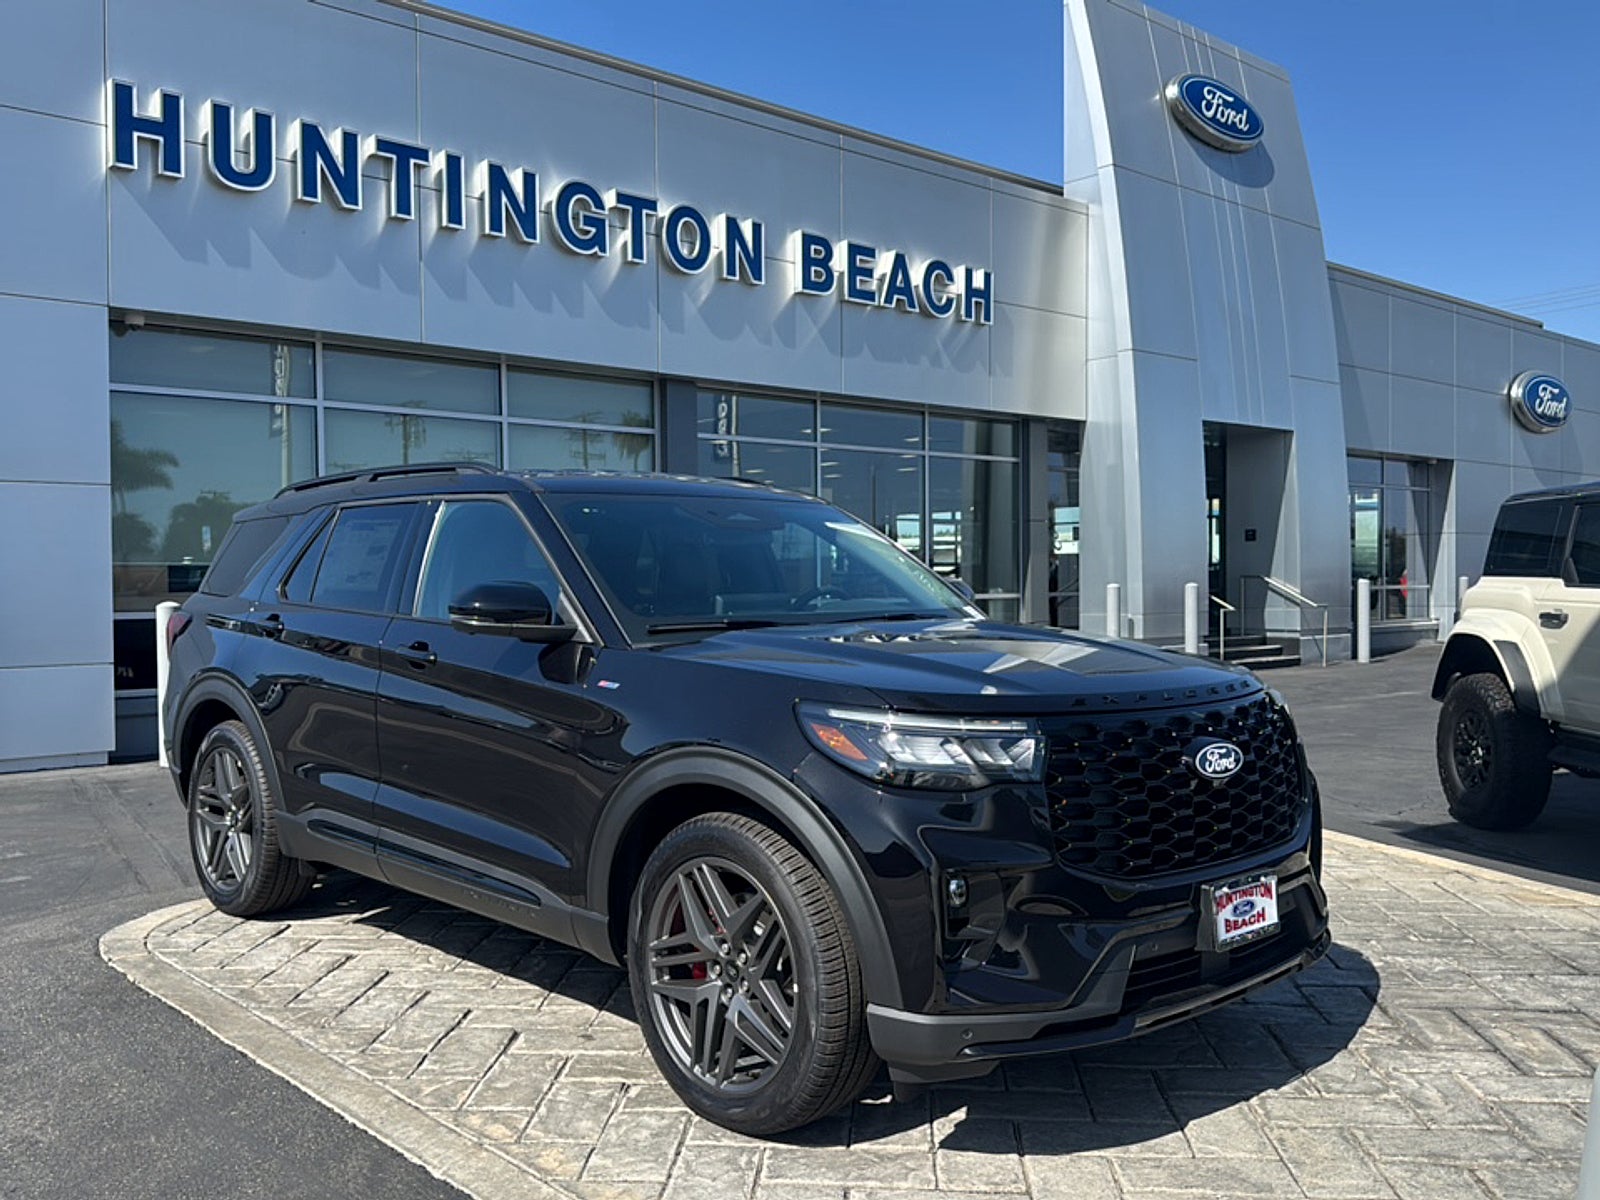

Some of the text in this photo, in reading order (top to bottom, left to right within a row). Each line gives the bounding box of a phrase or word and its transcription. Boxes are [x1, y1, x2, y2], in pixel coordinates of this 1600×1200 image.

[1201, 86, 1249, 131] Ford
[108, 78, 994, 325] HUNTINGTON BEACH
[1534, 383, 1567, 418] Ford
[1205, 748, 1236, 773] Ford
[1224, 907, 1266, 934] BEACH
